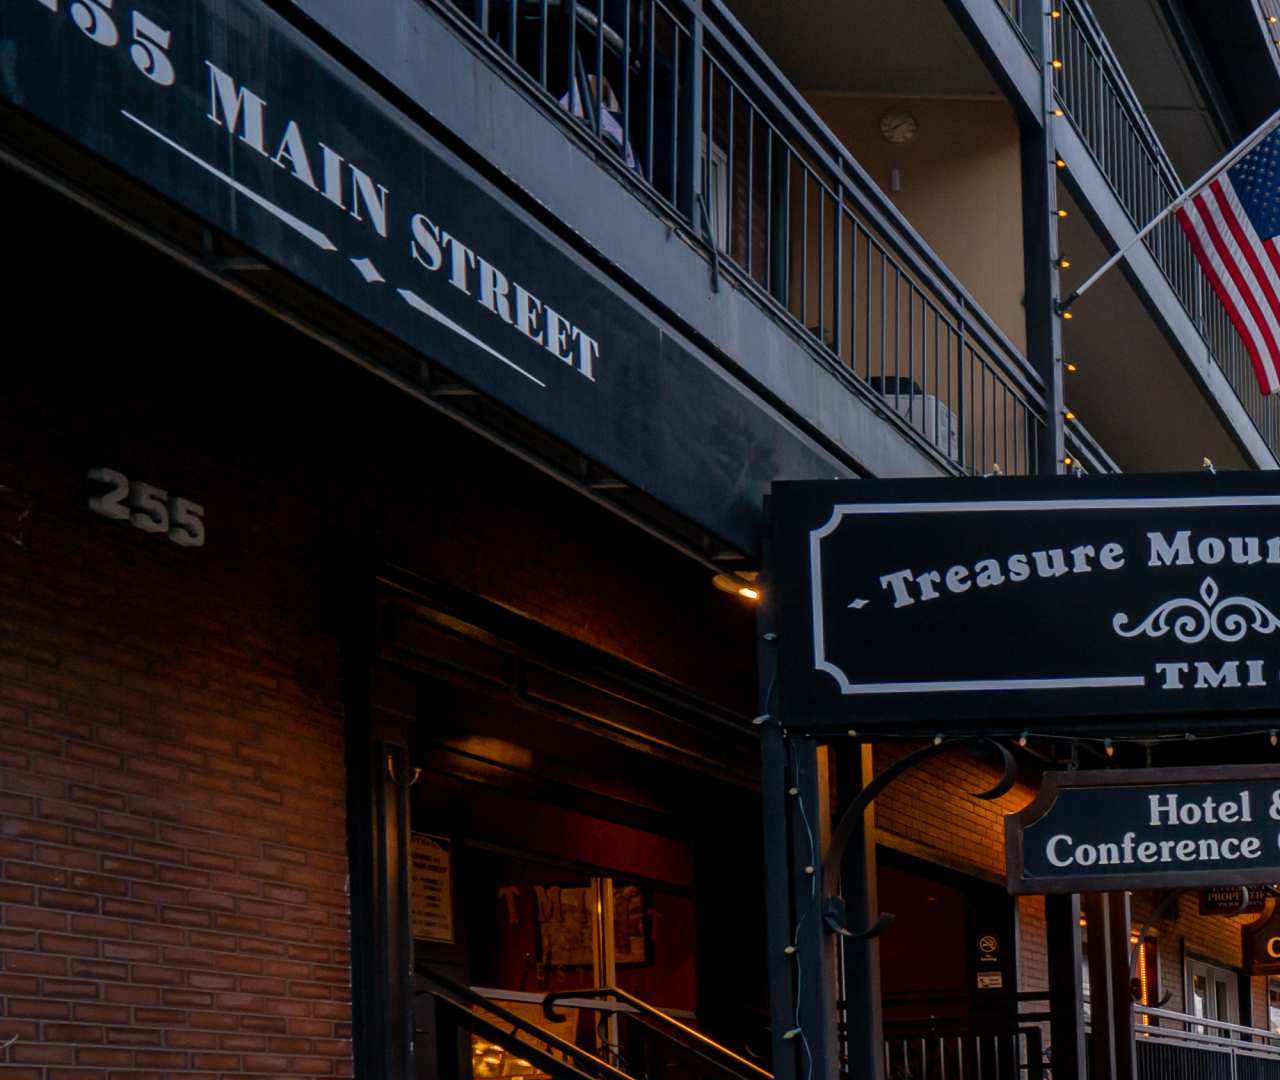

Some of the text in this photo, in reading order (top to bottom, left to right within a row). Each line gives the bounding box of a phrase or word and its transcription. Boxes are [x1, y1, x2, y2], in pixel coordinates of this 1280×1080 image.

[37, 0, 599, 382] 55 MAIN STREET
[87, 467, 206, 548] 255
[880, 541, 1124, 608] Treasure
[1155, 660, 1266, 690] TMI
[1149, 792, 1251, 826] Hotel
[1045, 830, 1261, 868] Conference
